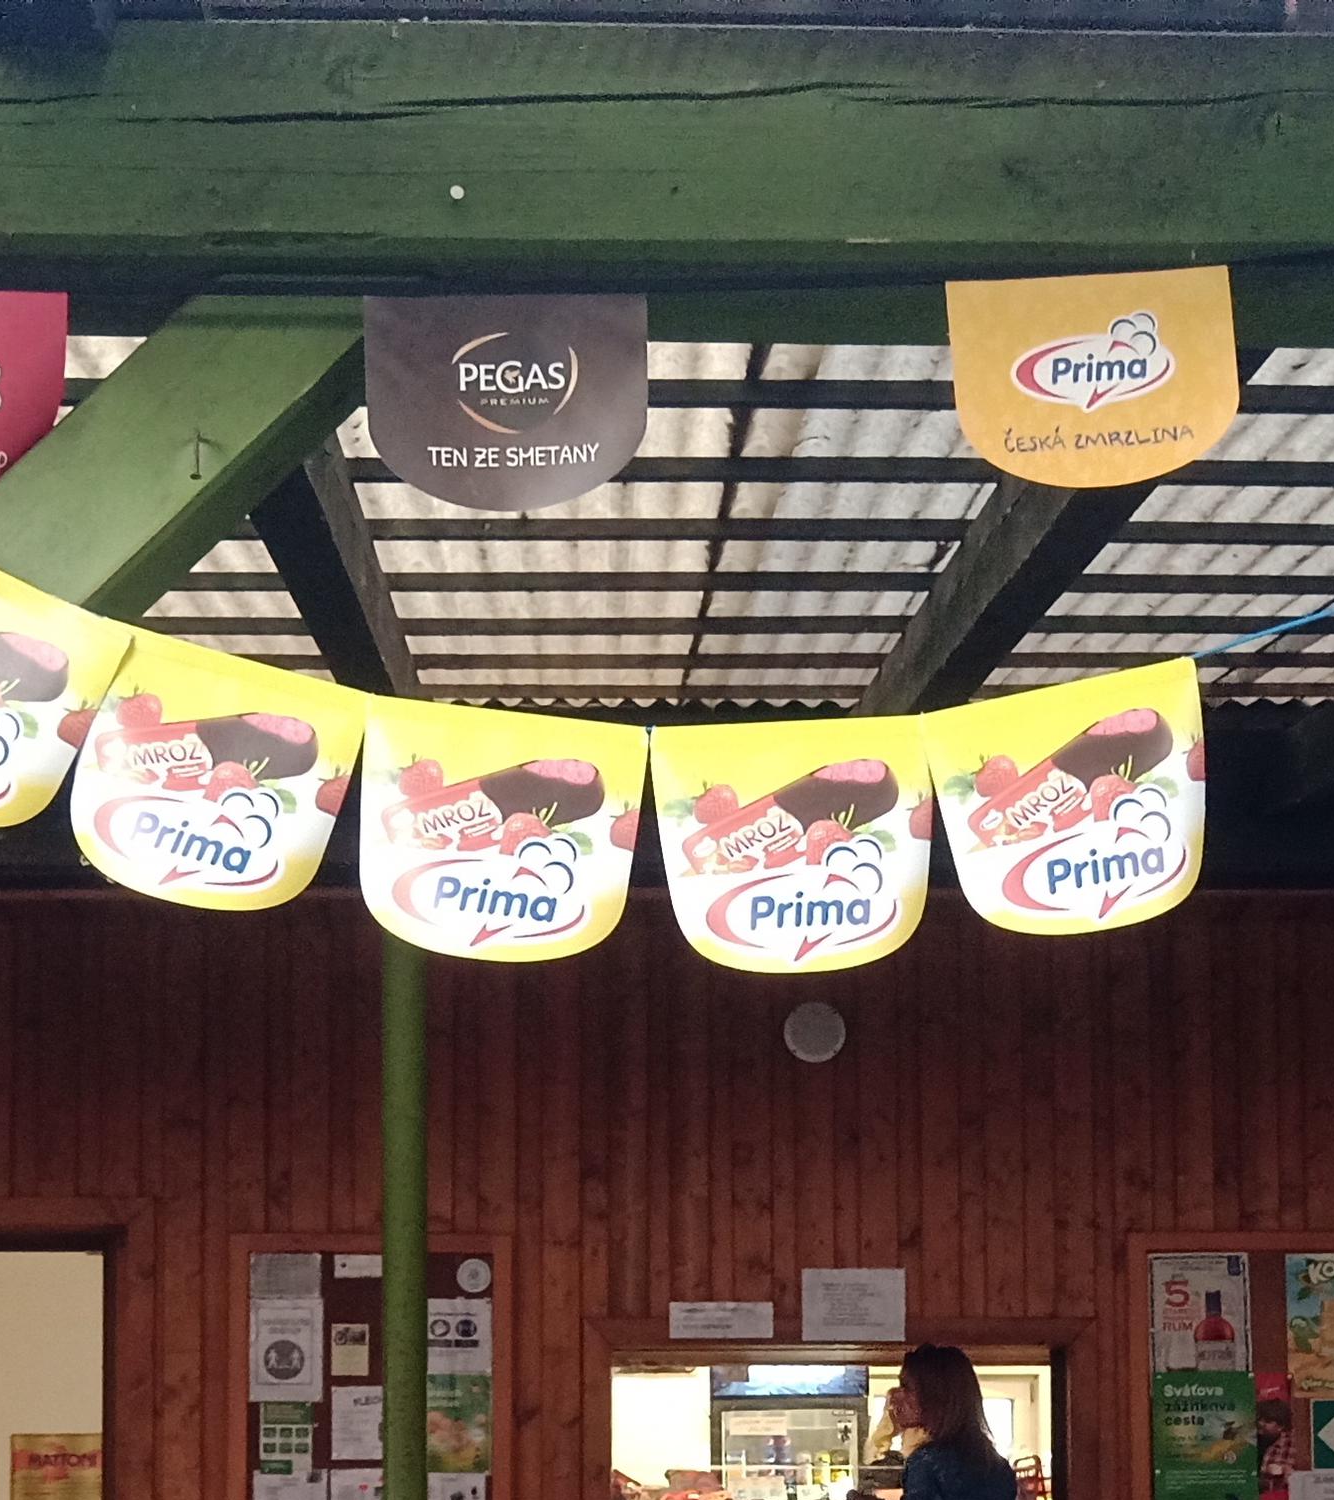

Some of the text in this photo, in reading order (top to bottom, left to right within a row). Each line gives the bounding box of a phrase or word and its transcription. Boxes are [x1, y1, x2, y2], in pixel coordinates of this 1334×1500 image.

[458, 360, 565, 393] PEGAS
[1051, 354, 1147, 385] Prima
[480, 397, 549, 405] PREMIUM
[427, 443, 599, 467] TEN ZE SMETANY
[1003, 423, 1194, 454] ČESKÁ ZMRZLINA
[130, 811, 252, 874] Prima
[1045, 845, 1165, 895] Prima
[432, 875, 558, 922] Prima
[749, 890, 872, 931] Prima
